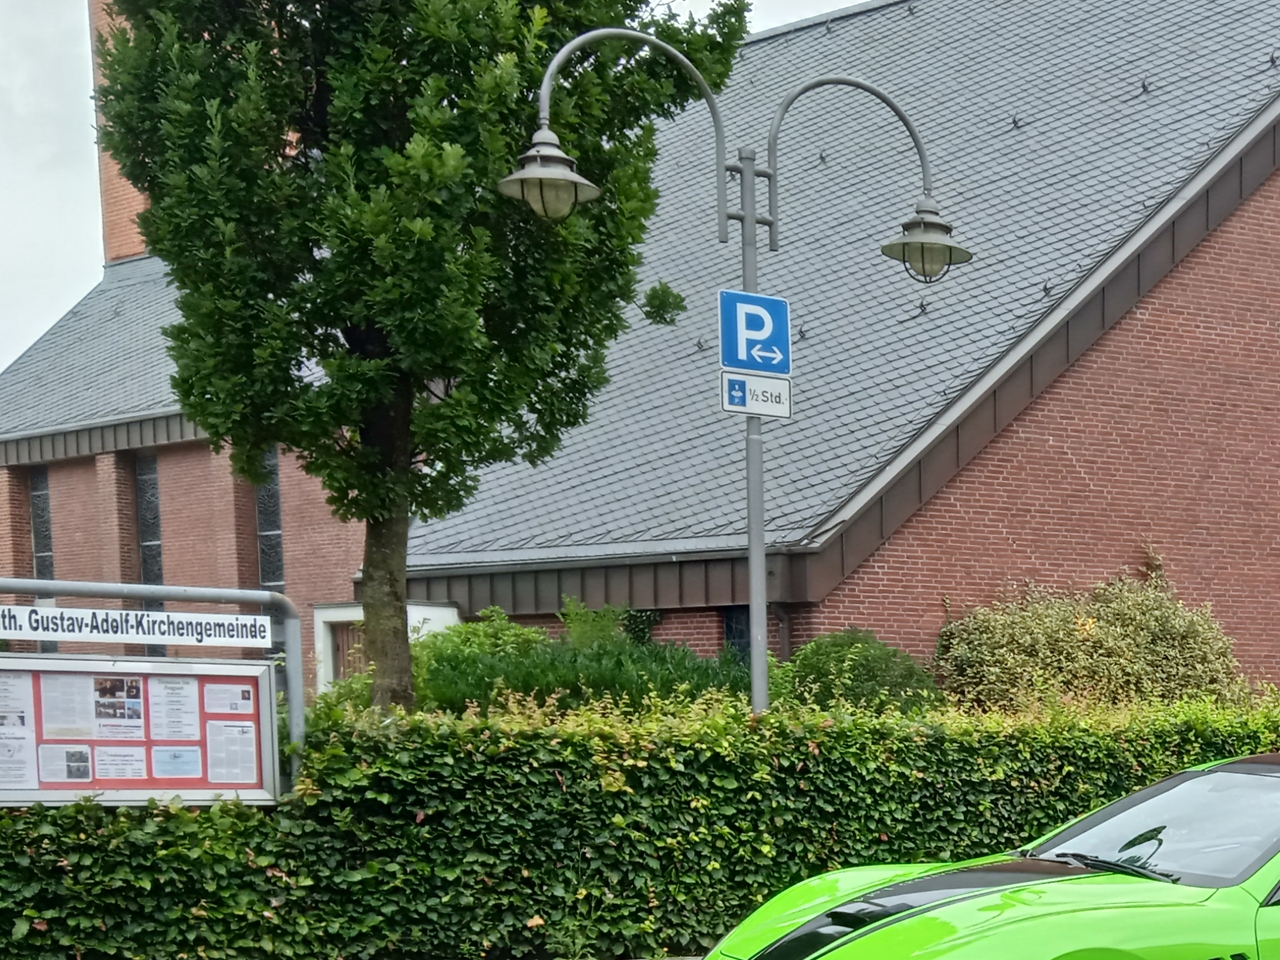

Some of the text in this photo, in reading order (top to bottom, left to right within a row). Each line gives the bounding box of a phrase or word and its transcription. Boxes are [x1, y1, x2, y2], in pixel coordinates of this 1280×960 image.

[736, 302, 774, 361] P
[761, 390, 785, 405] Std.
[28, 608, 267, 643] Gustav-Adolf-Kirchengemeinde
